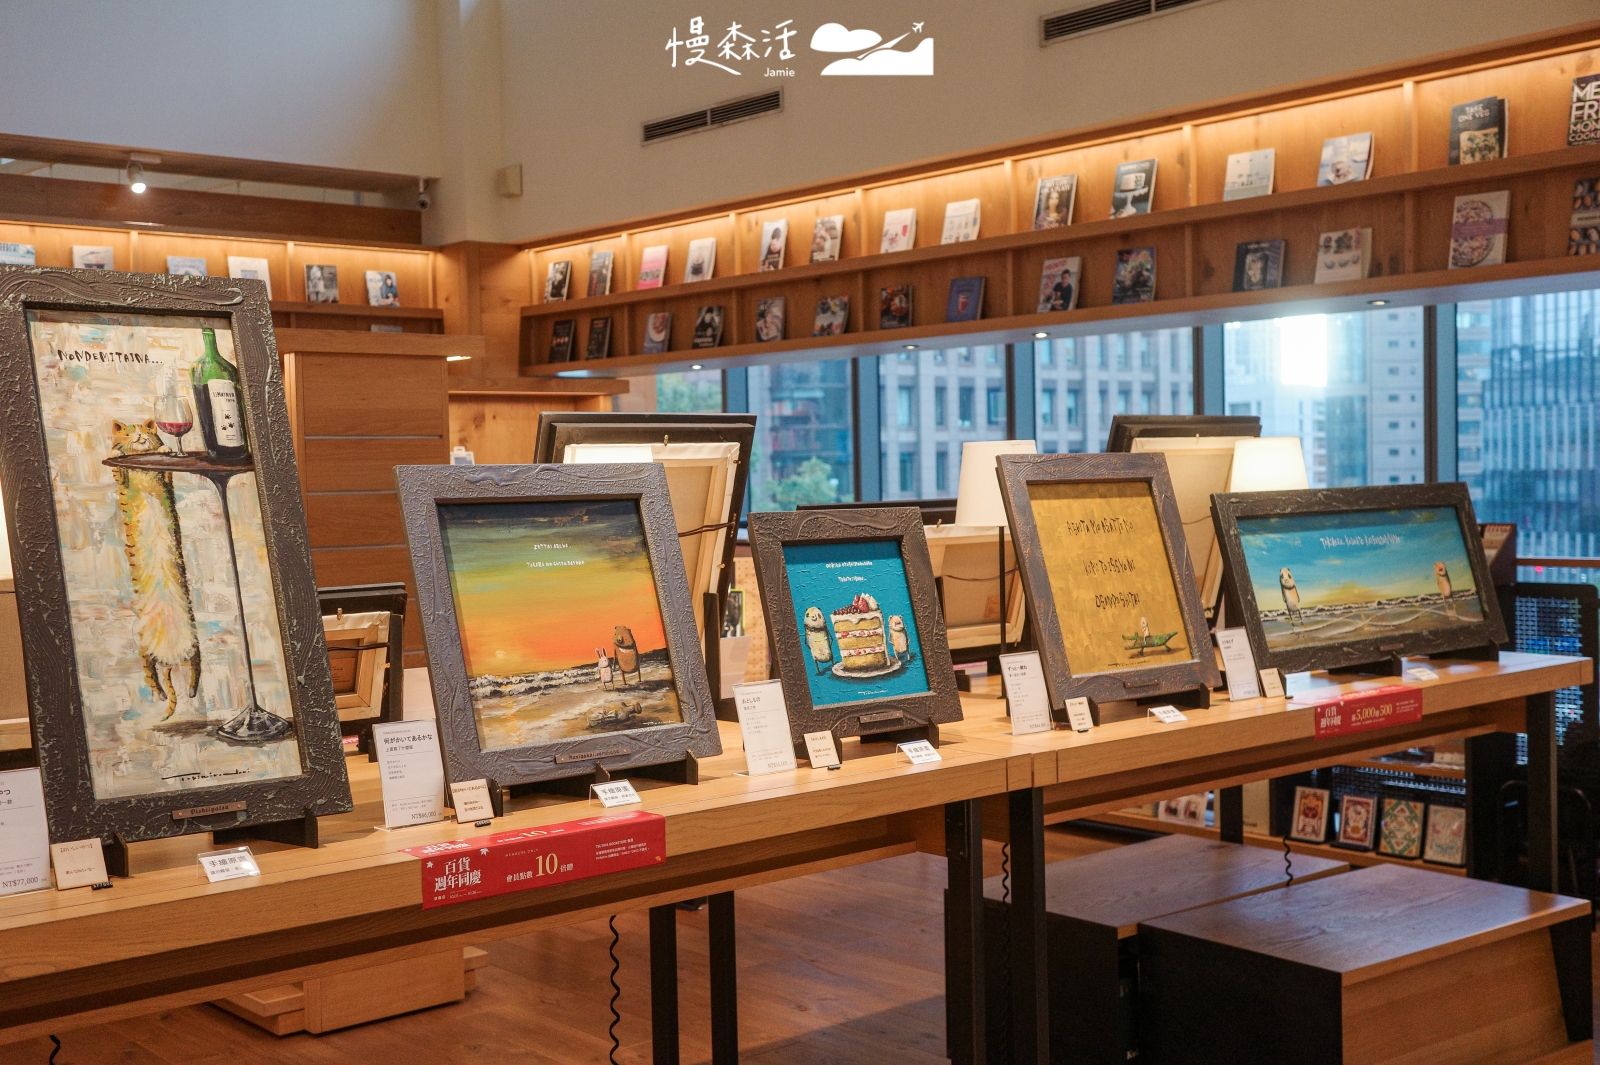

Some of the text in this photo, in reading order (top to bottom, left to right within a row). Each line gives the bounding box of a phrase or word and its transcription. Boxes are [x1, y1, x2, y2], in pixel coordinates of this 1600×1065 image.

[1571, 101, 1600, 122] FR
[383, 733, 433, 745] 何がかいてあるかな
[444, 856, 471, 875] 百貨
[535, 852, 558, 877] 10
[2, 876, 39, 889] NT$77,000
[434, 869, 482, 892] 週年同慶
